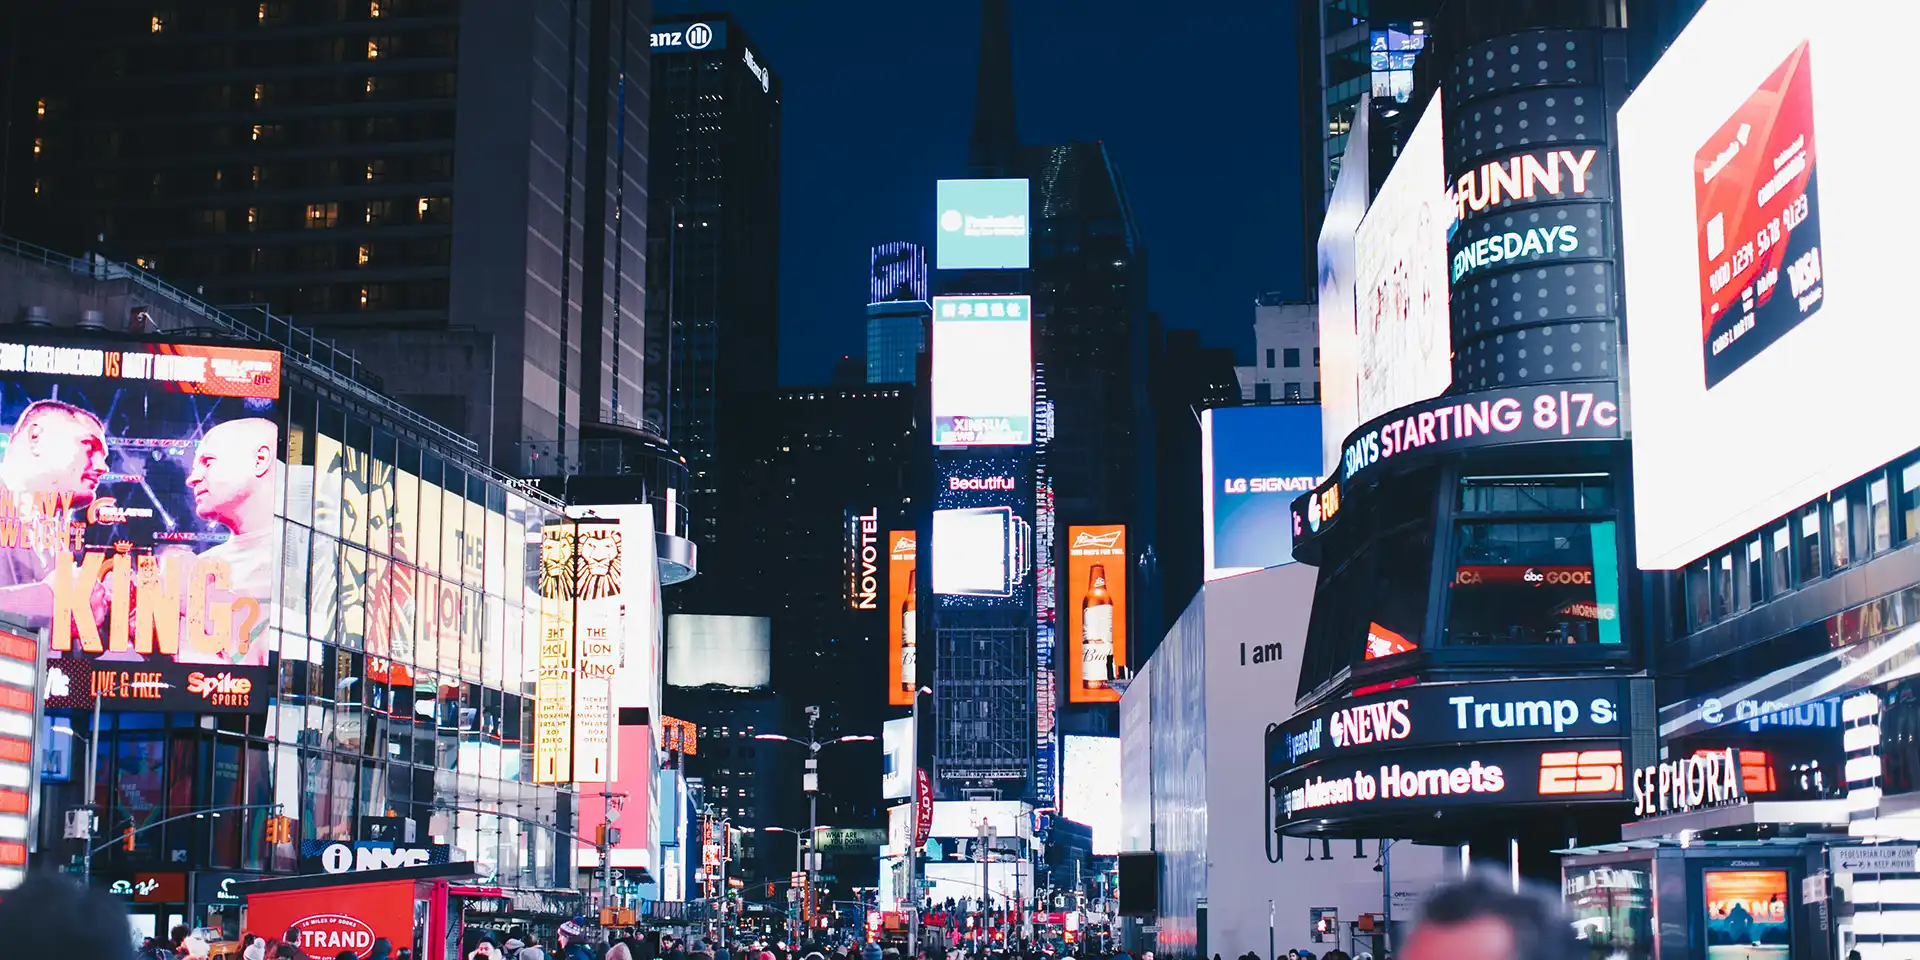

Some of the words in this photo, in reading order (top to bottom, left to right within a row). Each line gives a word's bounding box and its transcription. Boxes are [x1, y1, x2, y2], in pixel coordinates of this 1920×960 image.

[650, 31, 682, 47] anz
[1457, 150, 1597, 220] FUNNY
[104, 351, 120, 378] VS
[1380, 398, 1523, 459] STARTING
[950, 477, 1014, 491] Beautiful
[1225, 478, 1247, 493] LG
[455, 528, 483, 570] THE
[859, 507, 878, 609] NOVOTEL
[1523, 568, 1544, 582] abc
[51, 550, 261, 656] KING?
[1572, 604, 1615, 620] MORNING
[587, 628, 607, 638] THE
[582, 640, 612, 658] LION
[1240, 642, 1246, 666] I
[1252, 642, 1283, 665] am
[580, 659, 616, 680] KING
[90, 670, 117, 698] LIVE
[132, 672, 162, 699] FREE
[187, 671, 253, 698] Spike
[211, 694, 250, 706] SPORTS
[1342, 699, 1411, 747] NEWS
[1448, 696, 1579, 732] Trump
[1354, 770, 1376, 801] to
[1380, 760, 1505, 799] Hornets
[1633, 746, 1738, 816] SEPHORA
[357, 847, 430, 871] NYC
[1840, 850, 1877, 859] PEDESTRIAN
[1880, 849, 1896, 858] FLOW
[1898, 849, 1913, 858] ZONE
[1874, 860, 1889, 868] KEEP
[1891, 860, 1915, 868] MOVING
[338, 918, 357, 928] BOOKS
